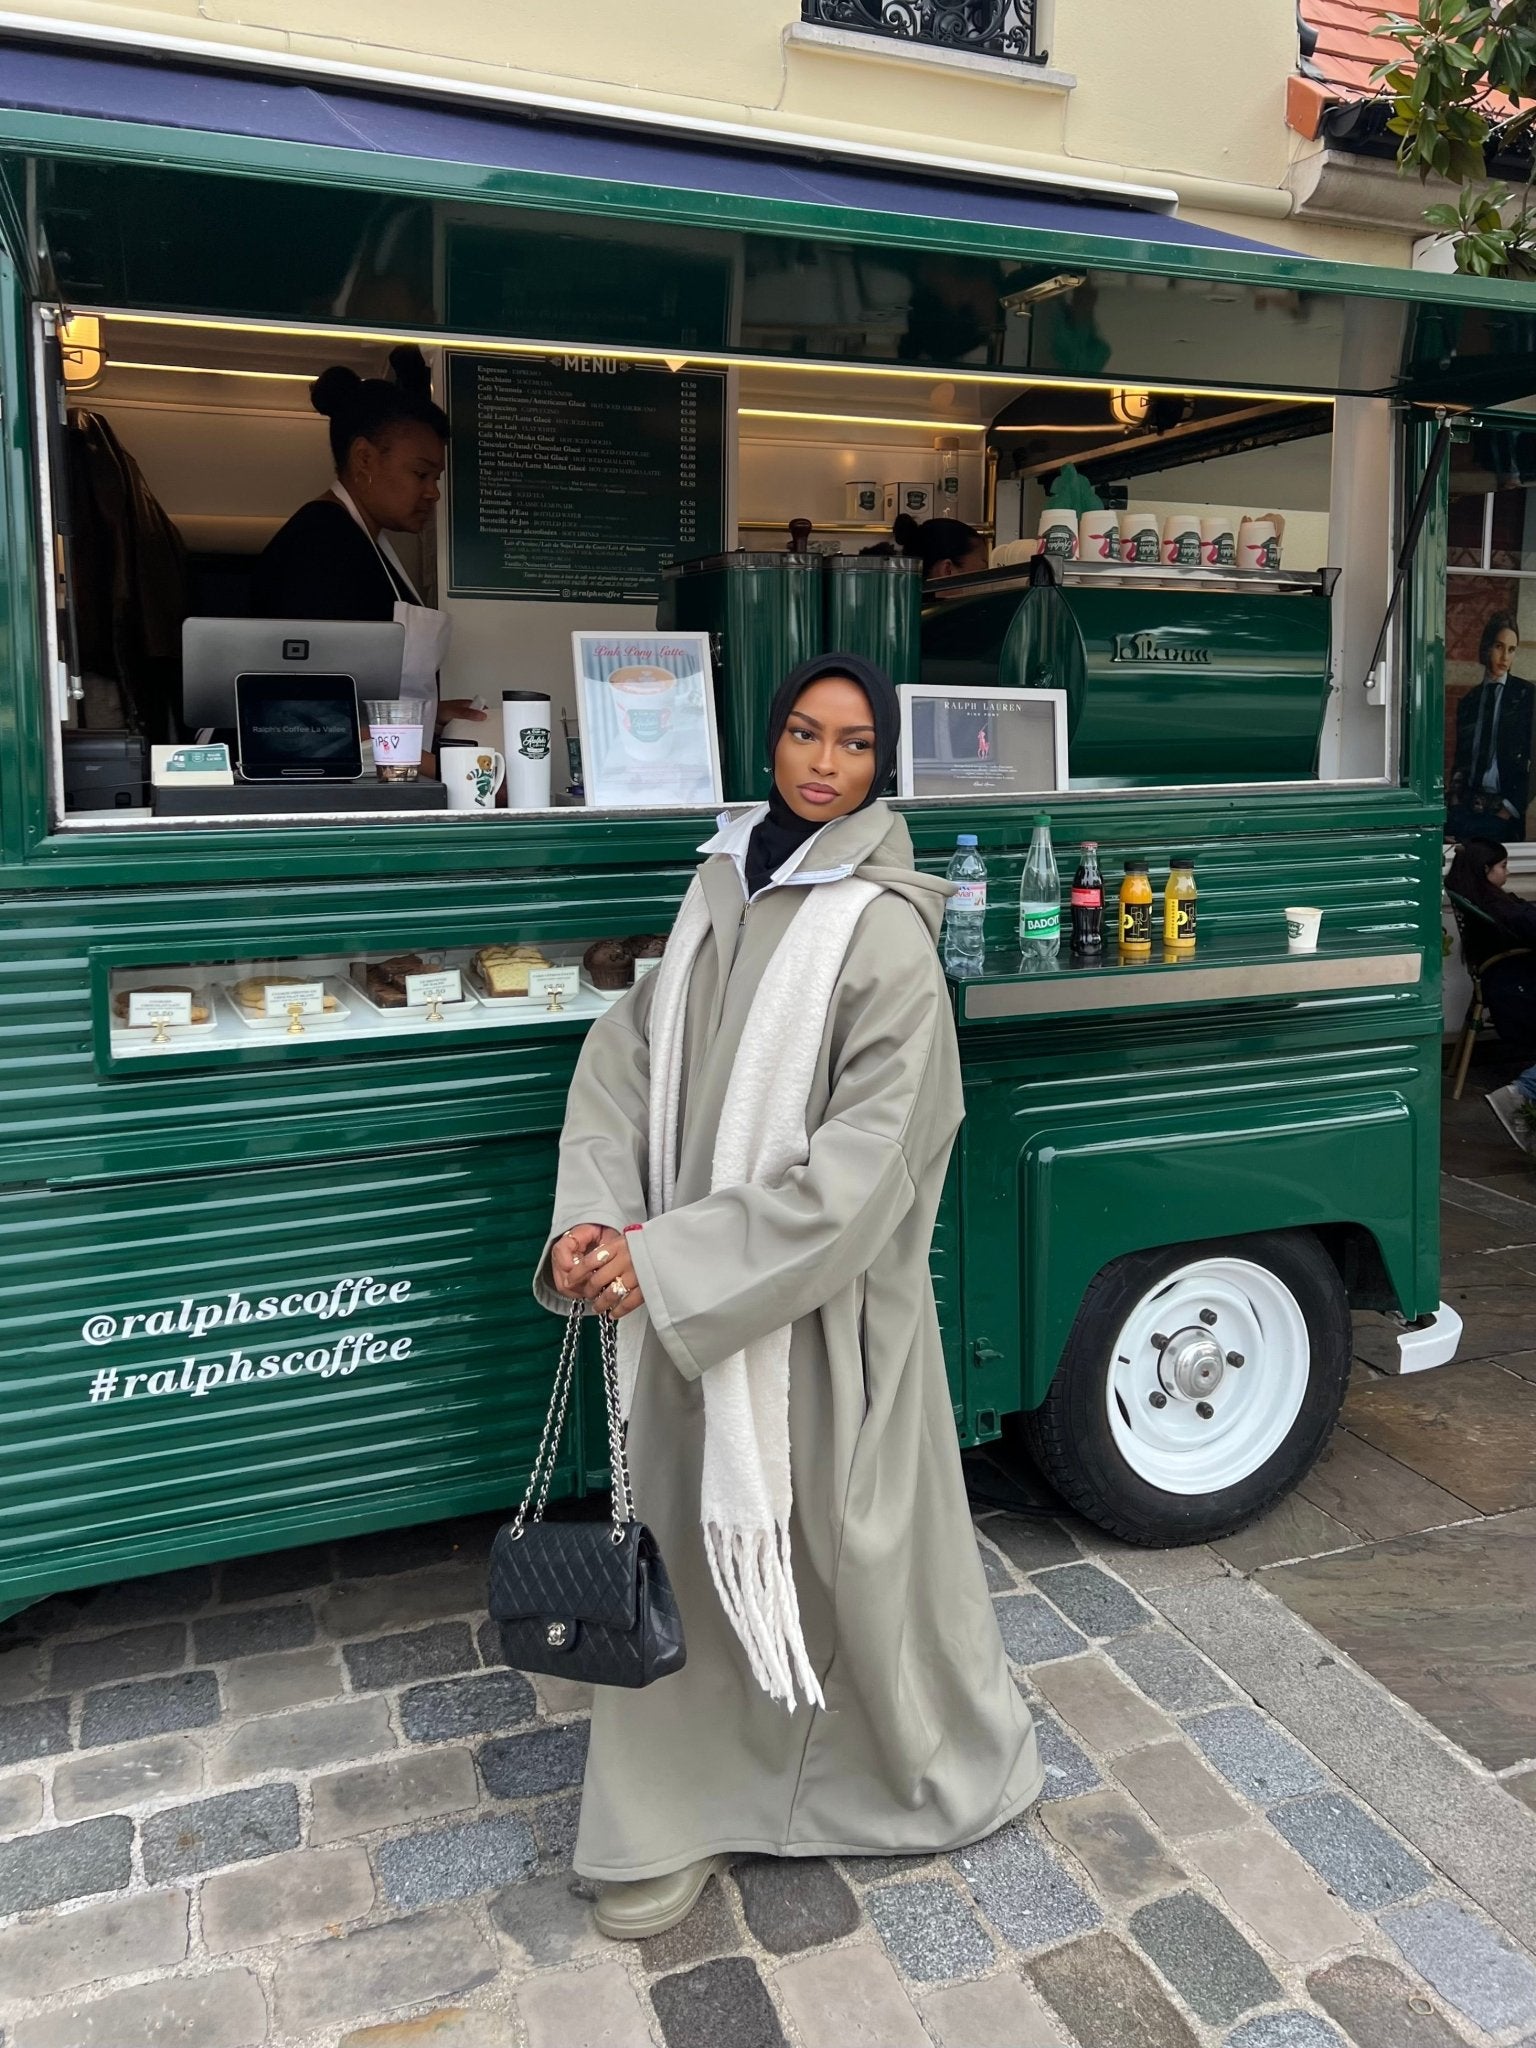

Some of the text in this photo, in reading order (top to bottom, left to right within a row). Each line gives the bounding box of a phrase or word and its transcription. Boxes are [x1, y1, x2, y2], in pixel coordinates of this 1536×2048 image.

[477, 365, 508, 375] Espresso
[563, 355, 617, 374] MENU
[493, 489, 512, 497] Glacé
[592, 645, 685, 660] Pink Pony Latte
[944, 701, 1022, 711] RALPH LAUREN
[252, 725, 281, 734] Ralph's
[282, 725, 310, 734] Coffee
[1027, 914, 1059, 930] BADOIT
[82, 1276, 412, 1346] @ralphscoffee
[88, 1332, 413, 1404] #ralphscoffee
